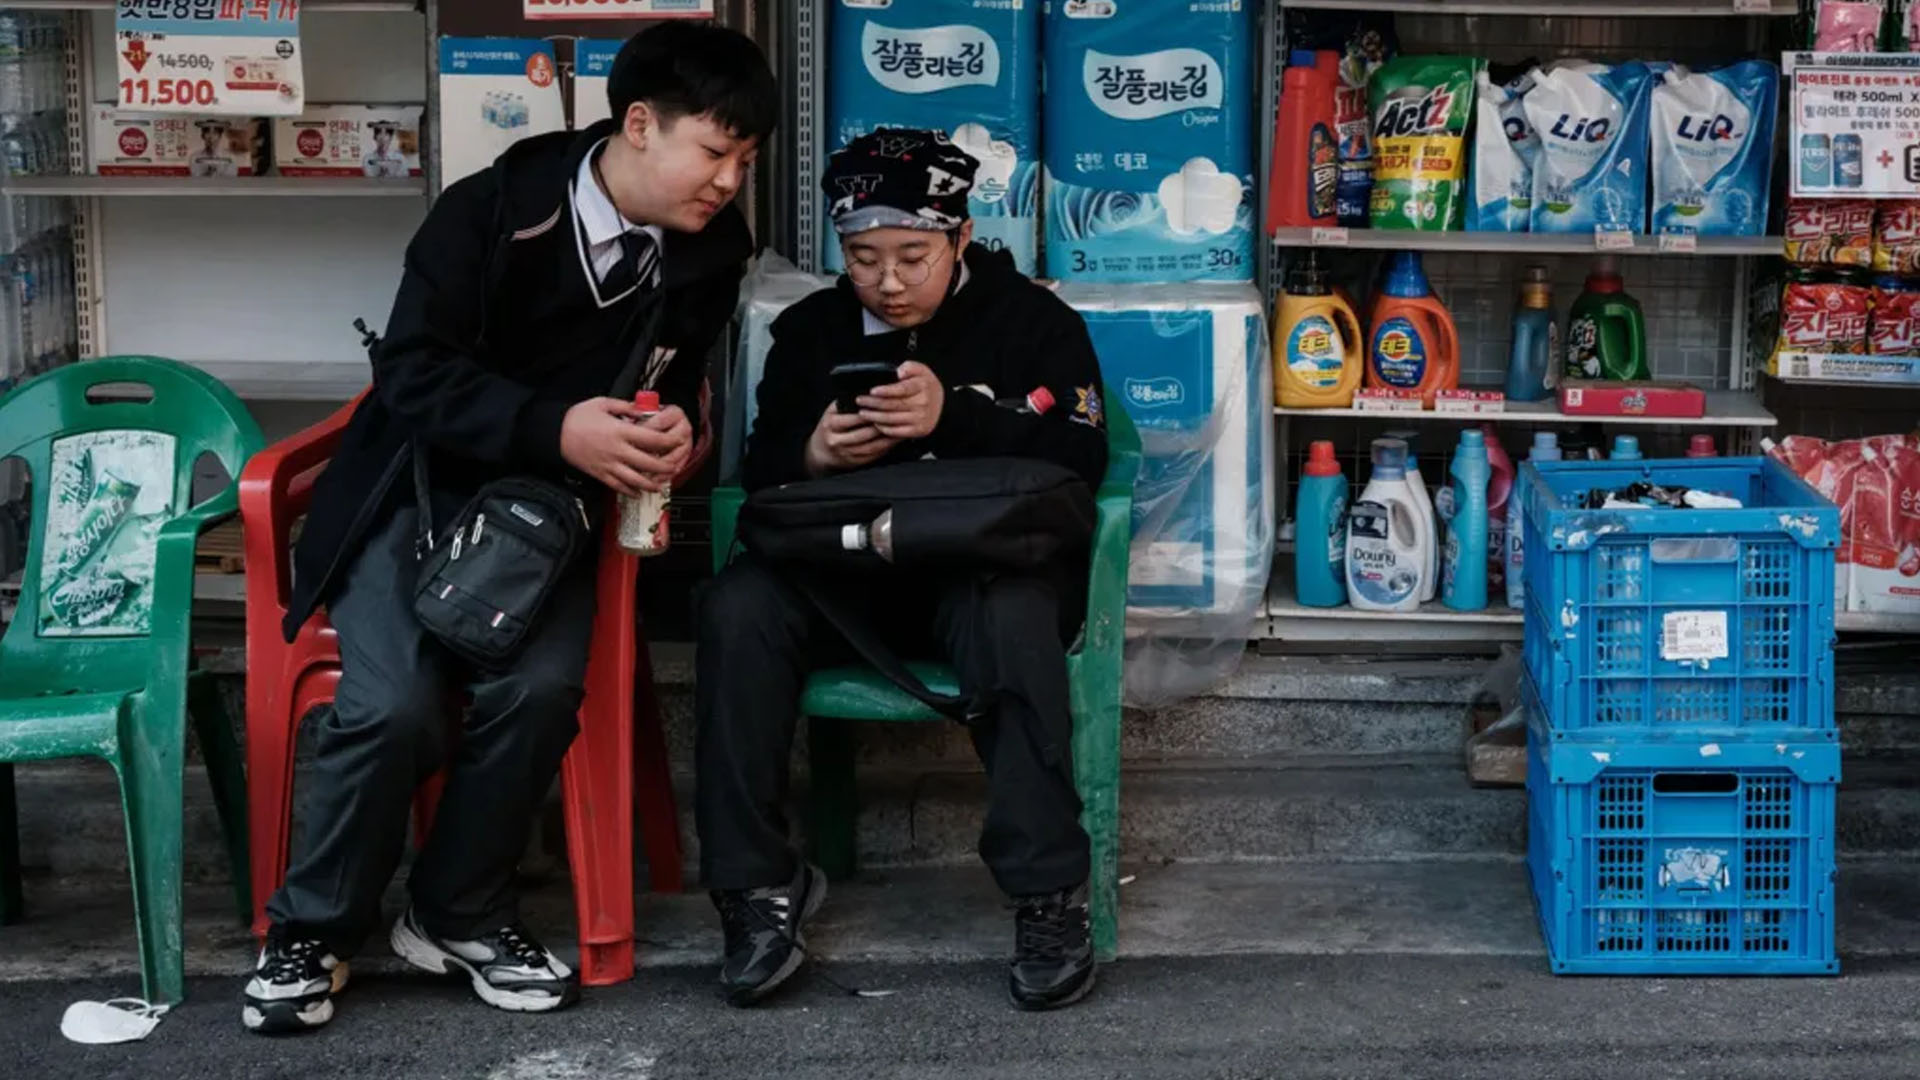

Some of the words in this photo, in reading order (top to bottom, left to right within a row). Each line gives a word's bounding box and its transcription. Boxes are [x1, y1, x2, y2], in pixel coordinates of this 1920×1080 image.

[872, 39, 985, 79] 잘풀리는집
[1094, 65, 1208, 105] 잘풀리는집
[1861, 91, 1903, 102] 500ml
[1786, 206, 1871, 240] 진라면
[1880, 209, 1920, 244] 진
[1785, 310, 1866, 345] 진라면
[1871, 319, 1920, 353] 진
[1354, 548, 1396, 567] Downy
